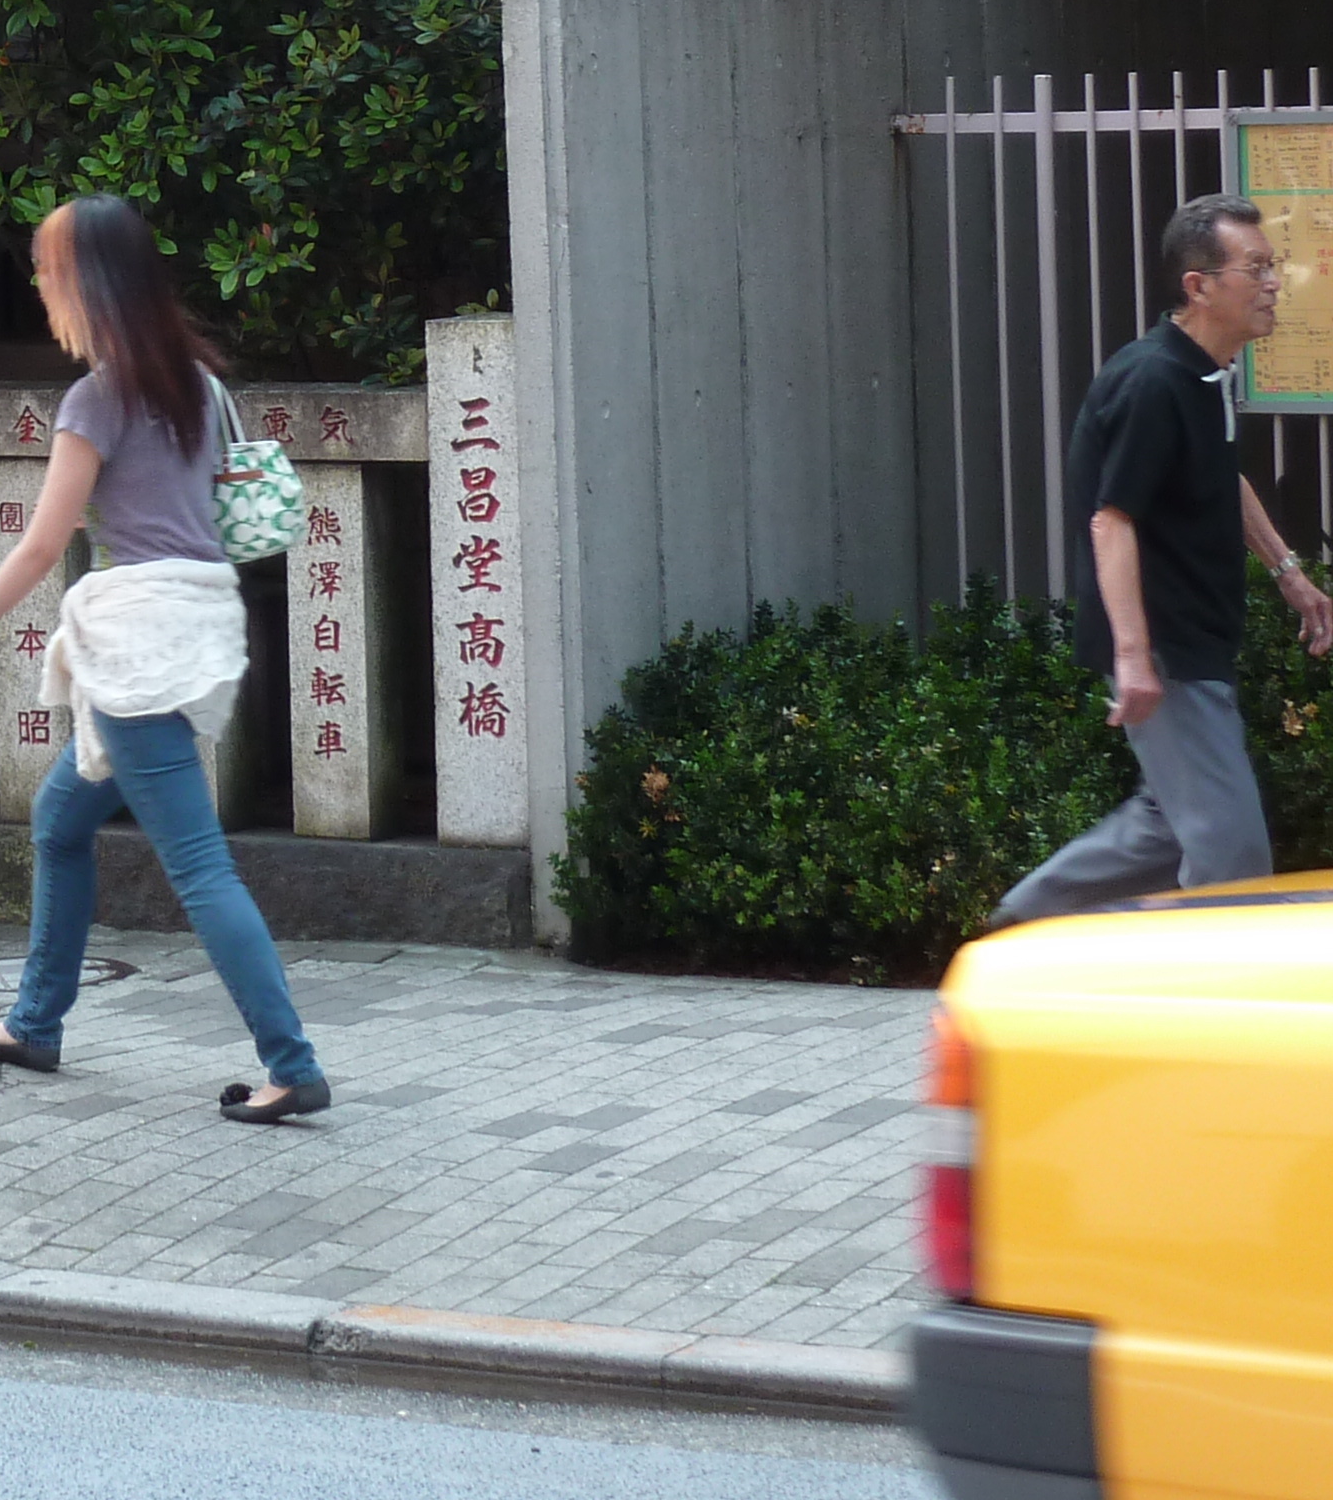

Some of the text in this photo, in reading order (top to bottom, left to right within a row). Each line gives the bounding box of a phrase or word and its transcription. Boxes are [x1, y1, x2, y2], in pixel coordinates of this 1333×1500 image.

[262, 404, 355, 446] 電気
[306, 505, 347, 760] 熊澤自転車
